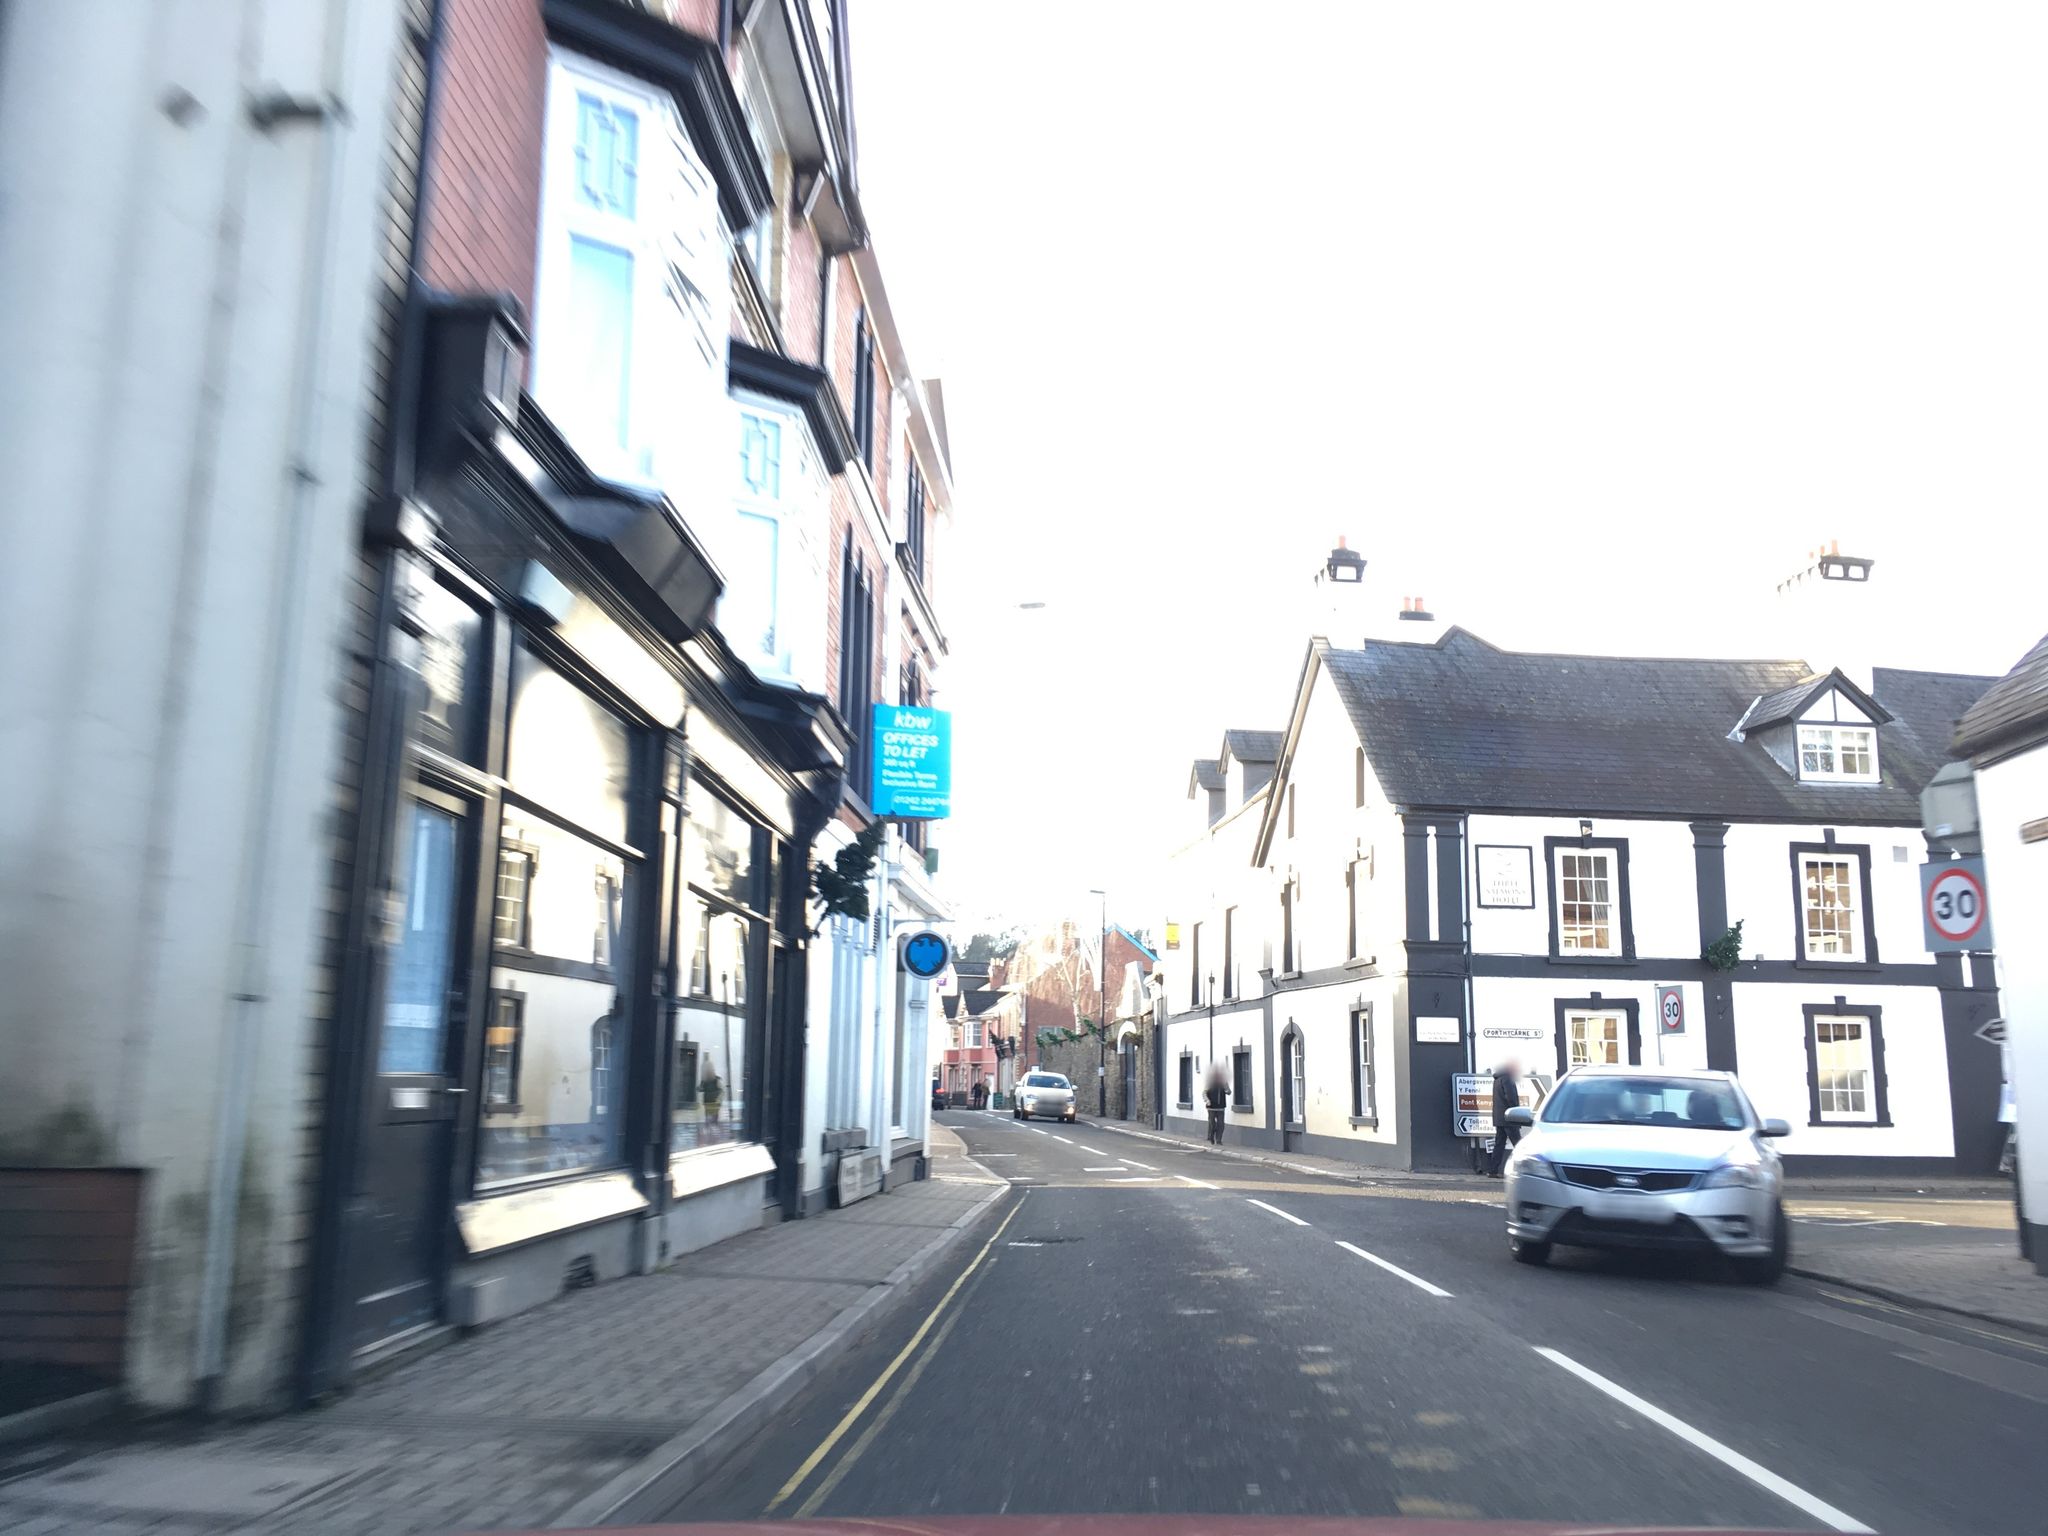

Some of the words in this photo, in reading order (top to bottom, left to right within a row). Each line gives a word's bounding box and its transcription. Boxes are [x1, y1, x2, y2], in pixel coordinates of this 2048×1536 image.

[894, 710, 932, 729] kbw
[883, 732, 939, 747] OFFICES
[883, 744, 902, 758] TO
[902, 746, 928, 759] LET
[1935, 889, 1976, 920] 30
[1665, 1002, 1679, 1018] 30
